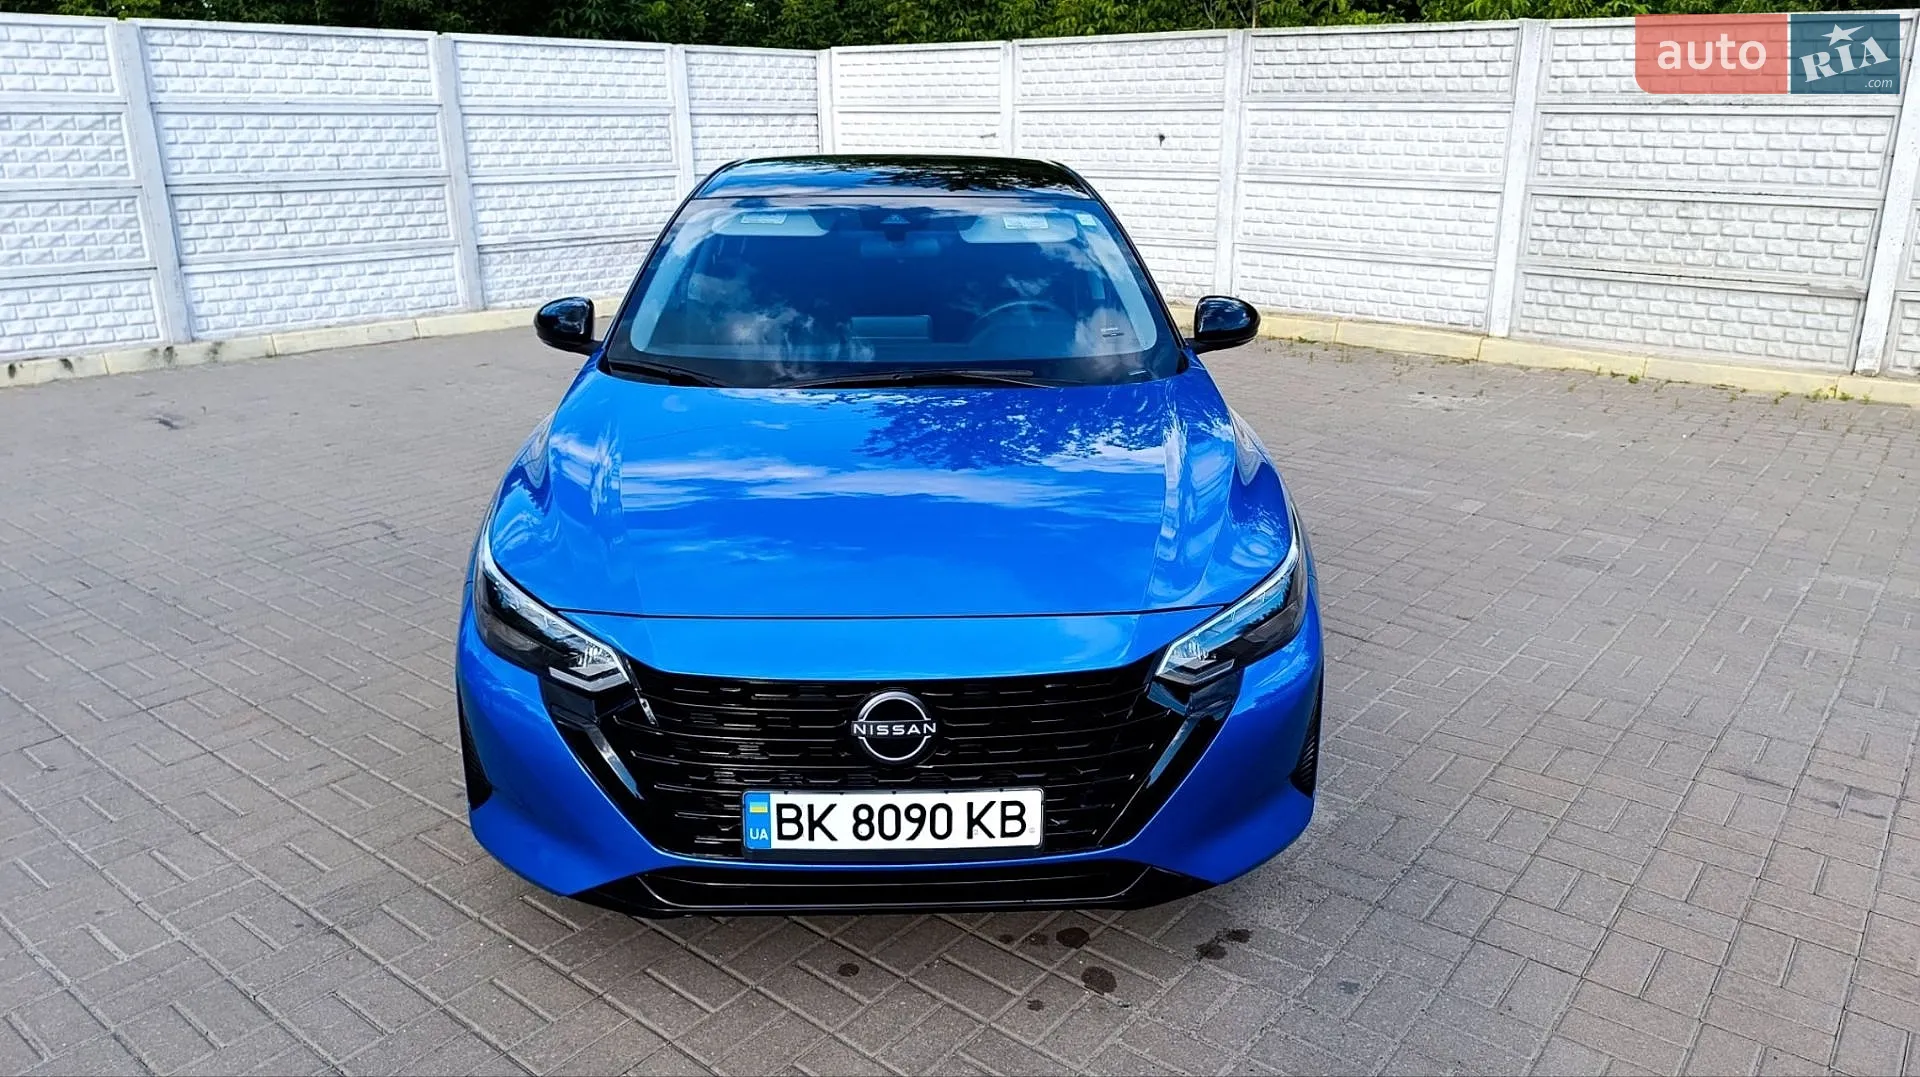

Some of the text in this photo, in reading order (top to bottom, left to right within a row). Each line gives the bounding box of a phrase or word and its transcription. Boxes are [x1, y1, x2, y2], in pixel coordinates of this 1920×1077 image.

[853, 722, 936, 736] NISSAN
[776, 800, 1027, 842] BK 8090 KB
[750, 828, 769, 840] UA
